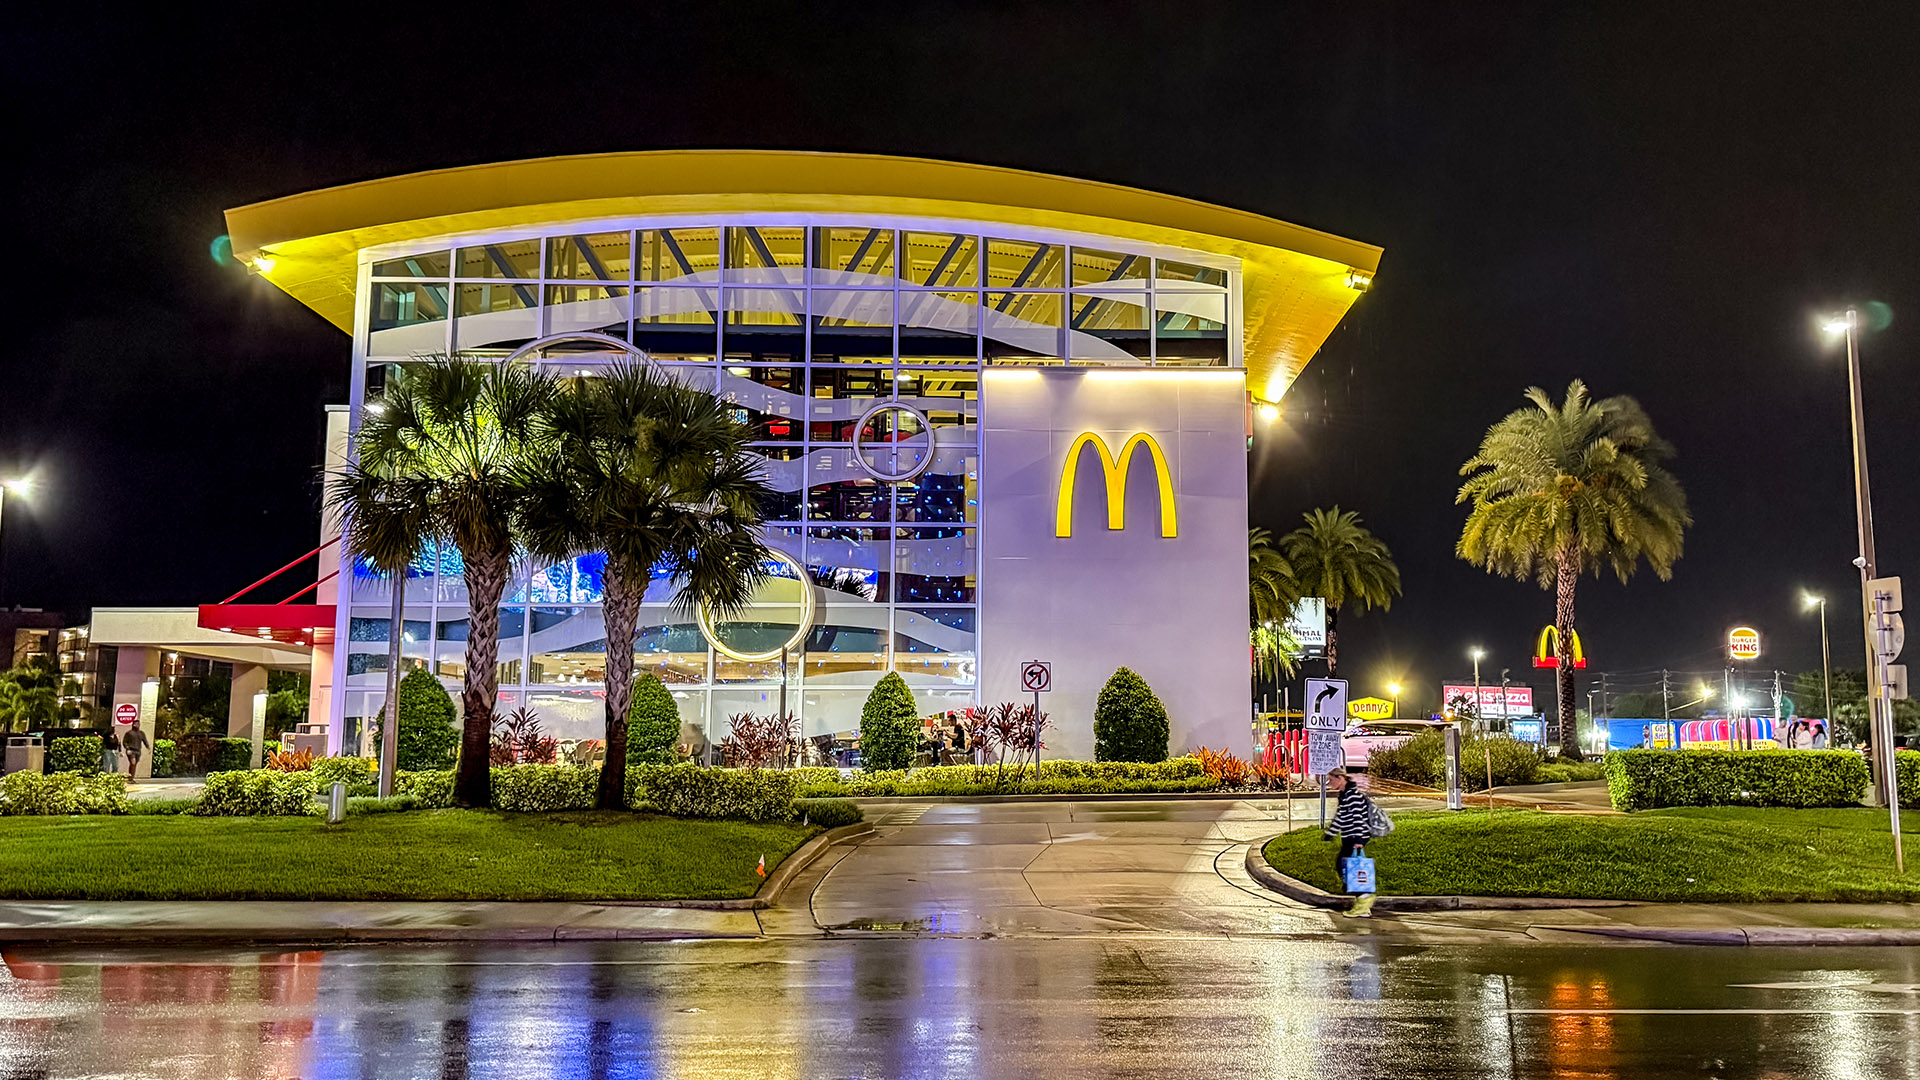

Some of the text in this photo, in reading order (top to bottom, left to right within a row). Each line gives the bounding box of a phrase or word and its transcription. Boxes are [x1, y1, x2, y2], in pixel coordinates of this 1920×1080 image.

[1495, 693, 1530, 704] pzza
[1352, 702, 1389, 714] Denny's
[1310, 716, 1340, 727] ONLY
[1318, 741, 1332, 750] ZONE
